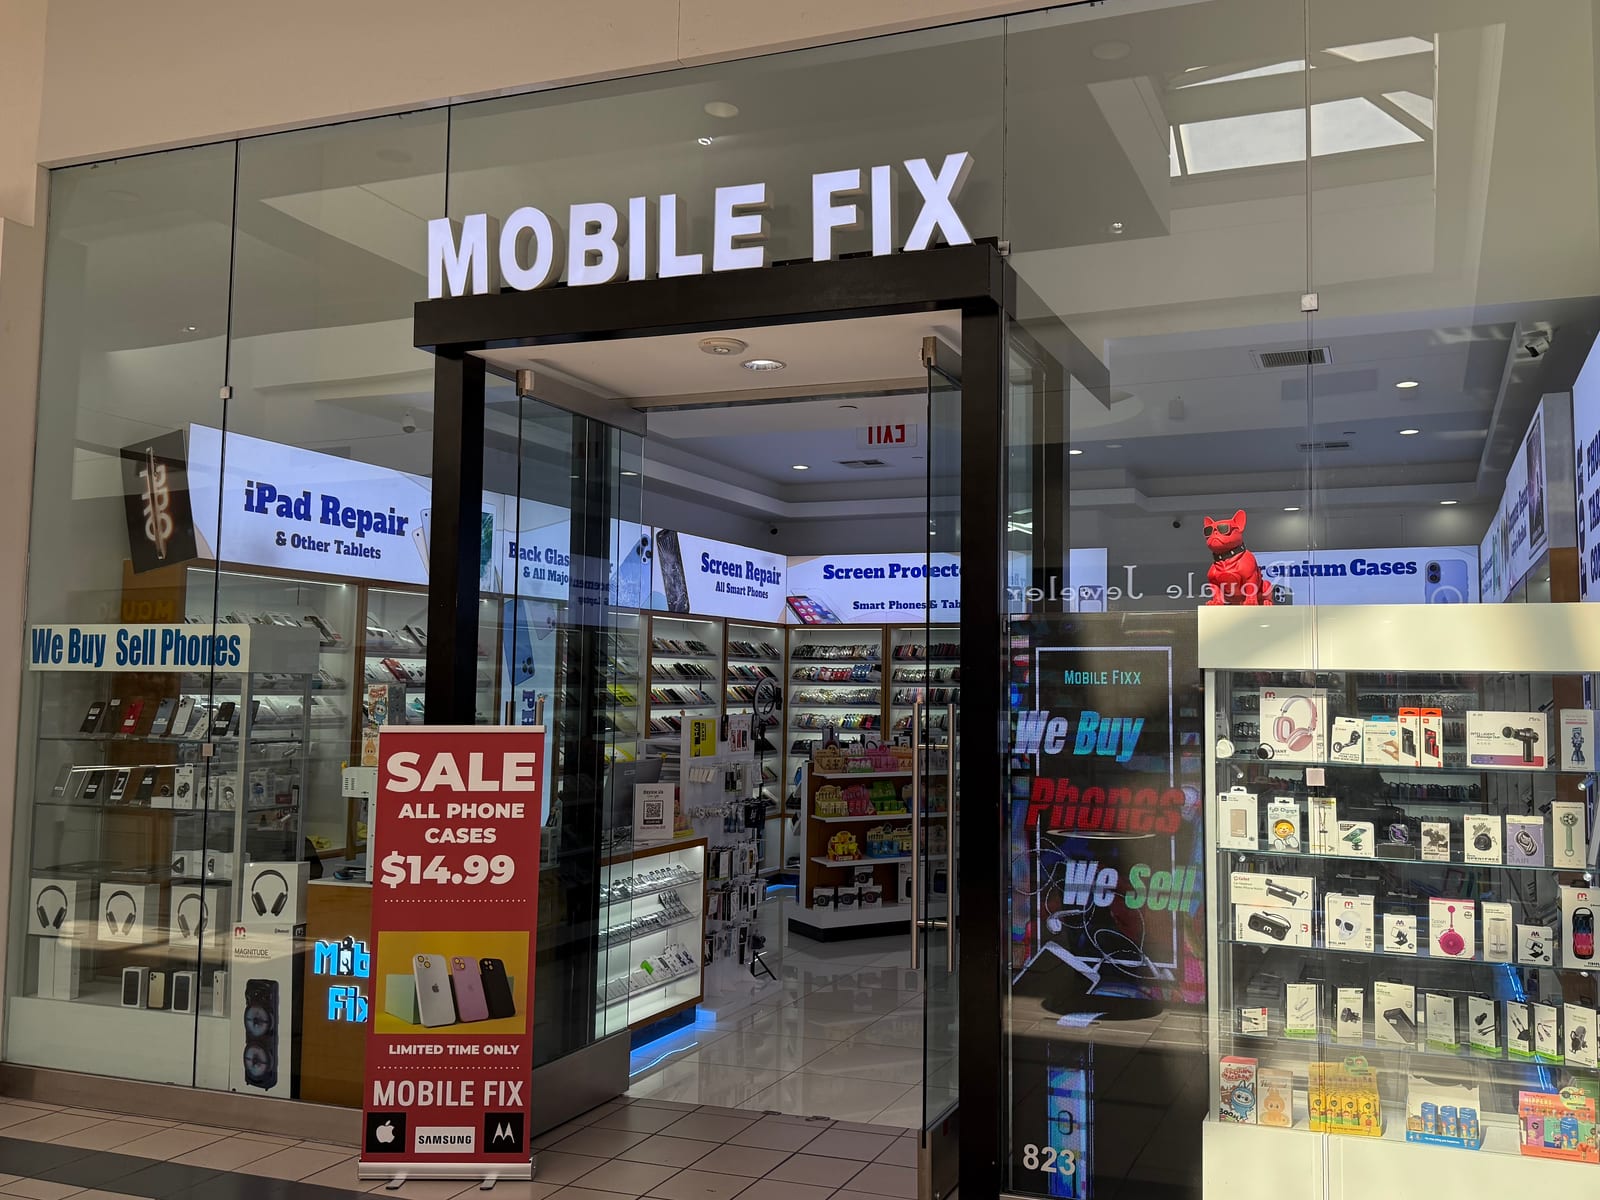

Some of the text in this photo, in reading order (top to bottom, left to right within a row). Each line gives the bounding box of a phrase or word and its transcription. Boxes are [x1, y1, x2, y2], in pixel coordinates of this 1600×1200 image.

[428, 151, 975, 300] MOBILE FIX
[139, 464, 174, 542] PRO
[243, 480, 409, 537] iPad Repair
[275, 531, 382, 560] & Other Tablets
[508, 541, 542, 563] Back
[523, 566, 569, 586] & All Majo
[700, 551, 782, 587] Screen Repair
[823, 563, 961, 580] Screen Protect
[1258, 558, 1418, 578] remium Cases
[715, 581, 769, 600] All Smart Phones
[852, 600, 885, 610] Smart
[888, 600, 926, 610] Phones
[31, 628, 241, 667] We Buy Sell Phones
[1012, 710, 1145, 763] We Buy
[385, 751, 537, 793] SALE
[398, 802, 525, 819] ALL PHONE
[1024, 776, 1185, 834] Phones
[424, 827, 497, 844] CASES
[380, 850, 516, 889] $14.99
[1062, 860, 1197, 913] We Sell
[234, 947, 269, 956] MAGNITUDE
[388, 1044, 520, 1056] LIMITED TIME ONLY
[373, 1080, 524, 1107] MOBILE FIX
[418, 1134, 472, 1145] SAMSUNG
[1022, 1143, 1077, 1176] 823
